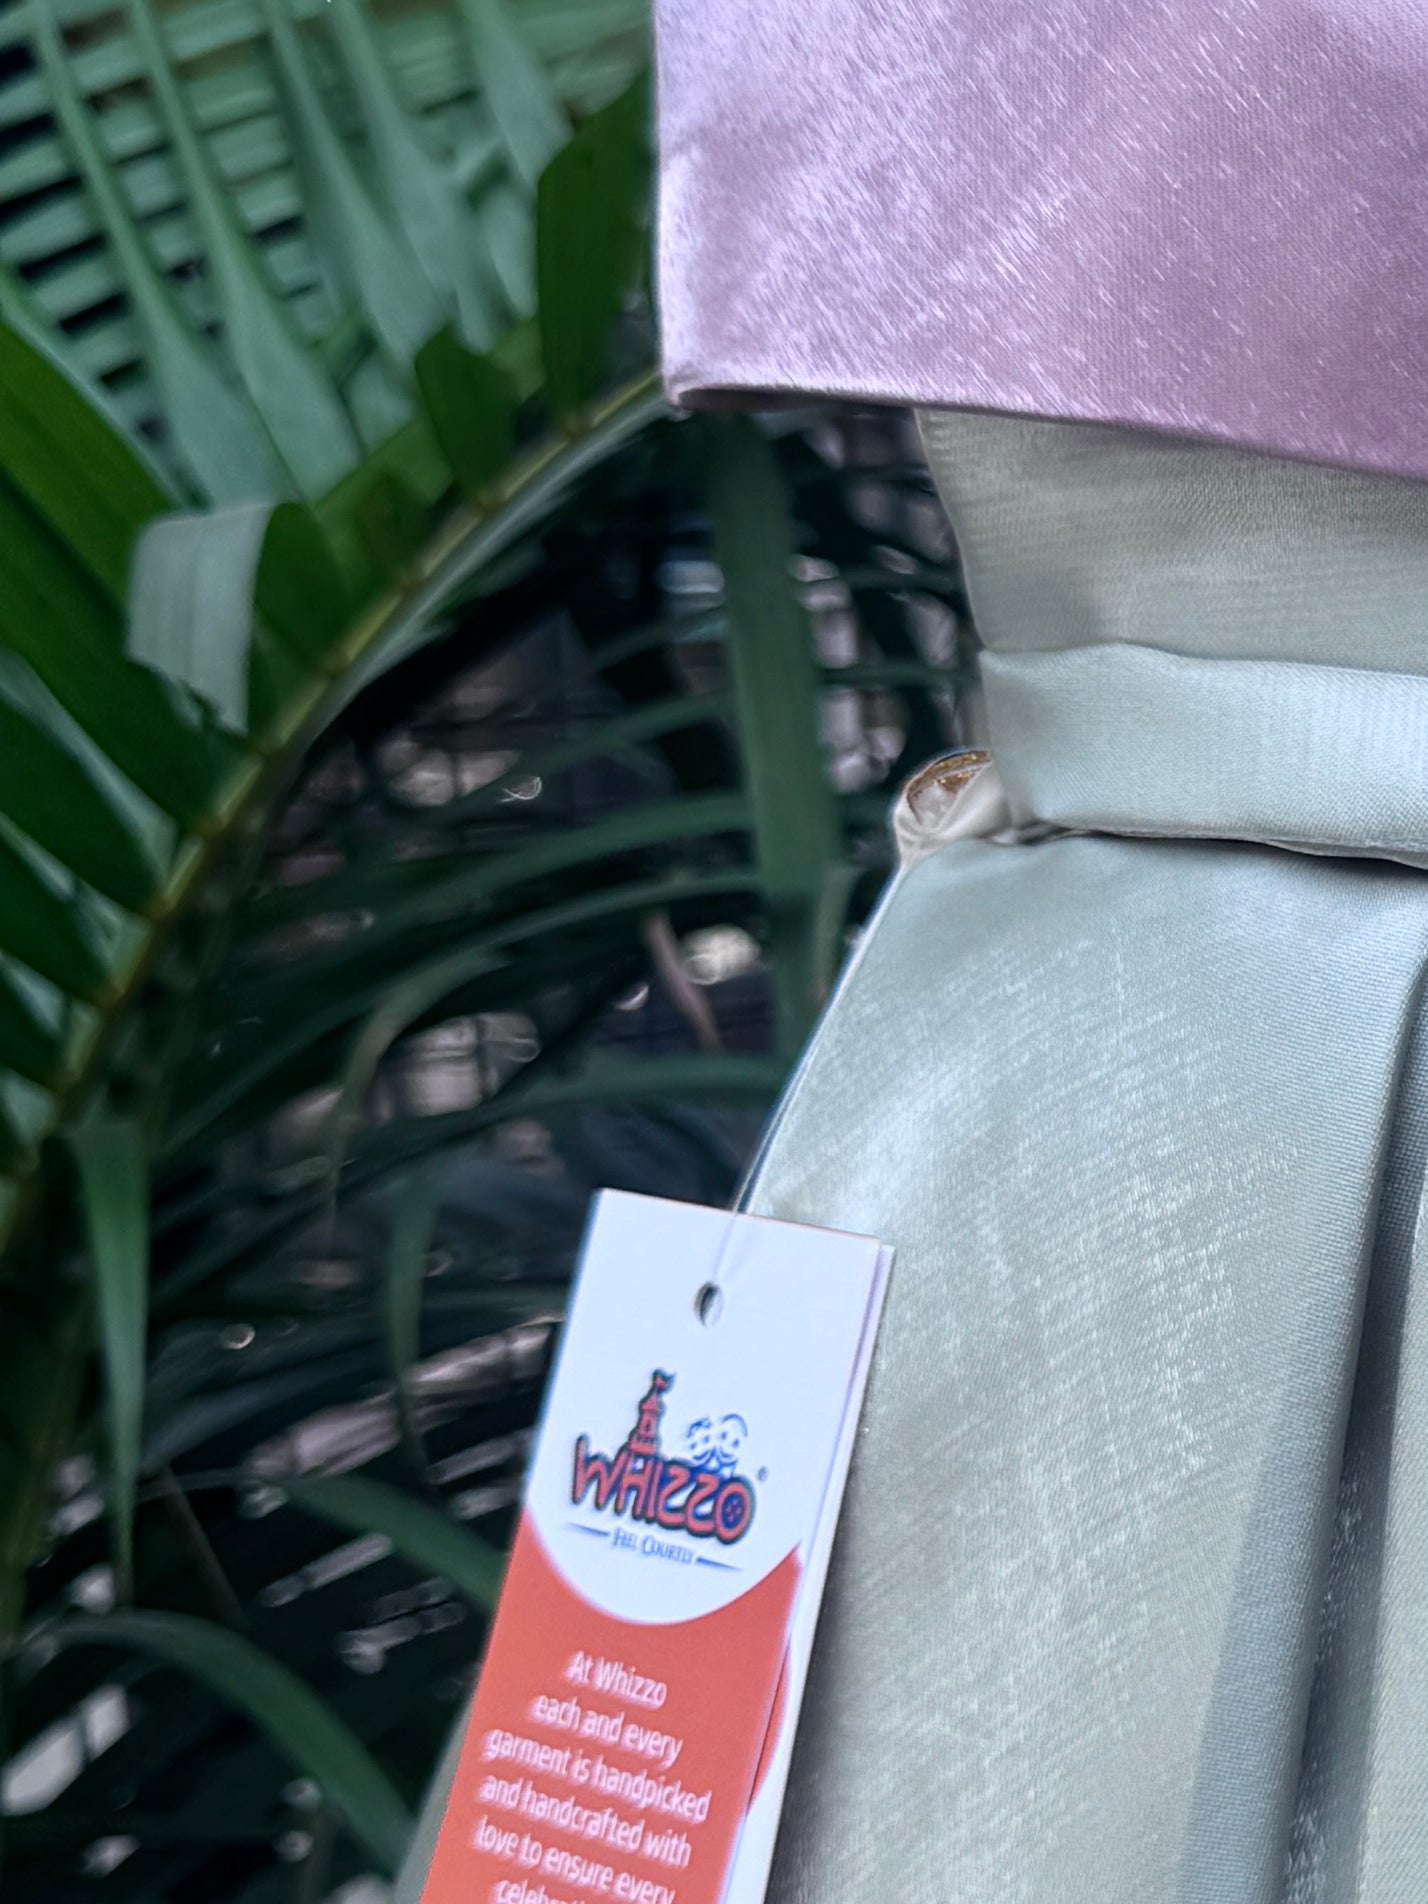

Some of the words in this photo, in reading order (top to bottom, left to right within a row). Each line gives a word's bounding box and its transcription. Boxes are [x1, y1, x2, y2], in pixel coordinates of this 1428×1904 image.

[571, 1432, 756, 1546] WHIZZO
[564, 1650, 595, 1685] At
[593, 1656, 668, 1711] Whizzo
[529, 1694, 581, 1730] each
[579, 1710, 625, 1747] and
[619, 1723, 684, 1771] every
[482, 1729, 573, 1778] garment
[568, 1747, 592, 1787] is
[591, 1754, 713, 1825] handpicked
[473, 1814, 519, 1858] love
[516, 1832, 543, 1869] to
[538, 1845, 614, 1891] ensure
[477, 1775, 525, 1813] and
[518, 1780, 645, 1853] handcrafted
[640, 1827, 693, 1870] with
